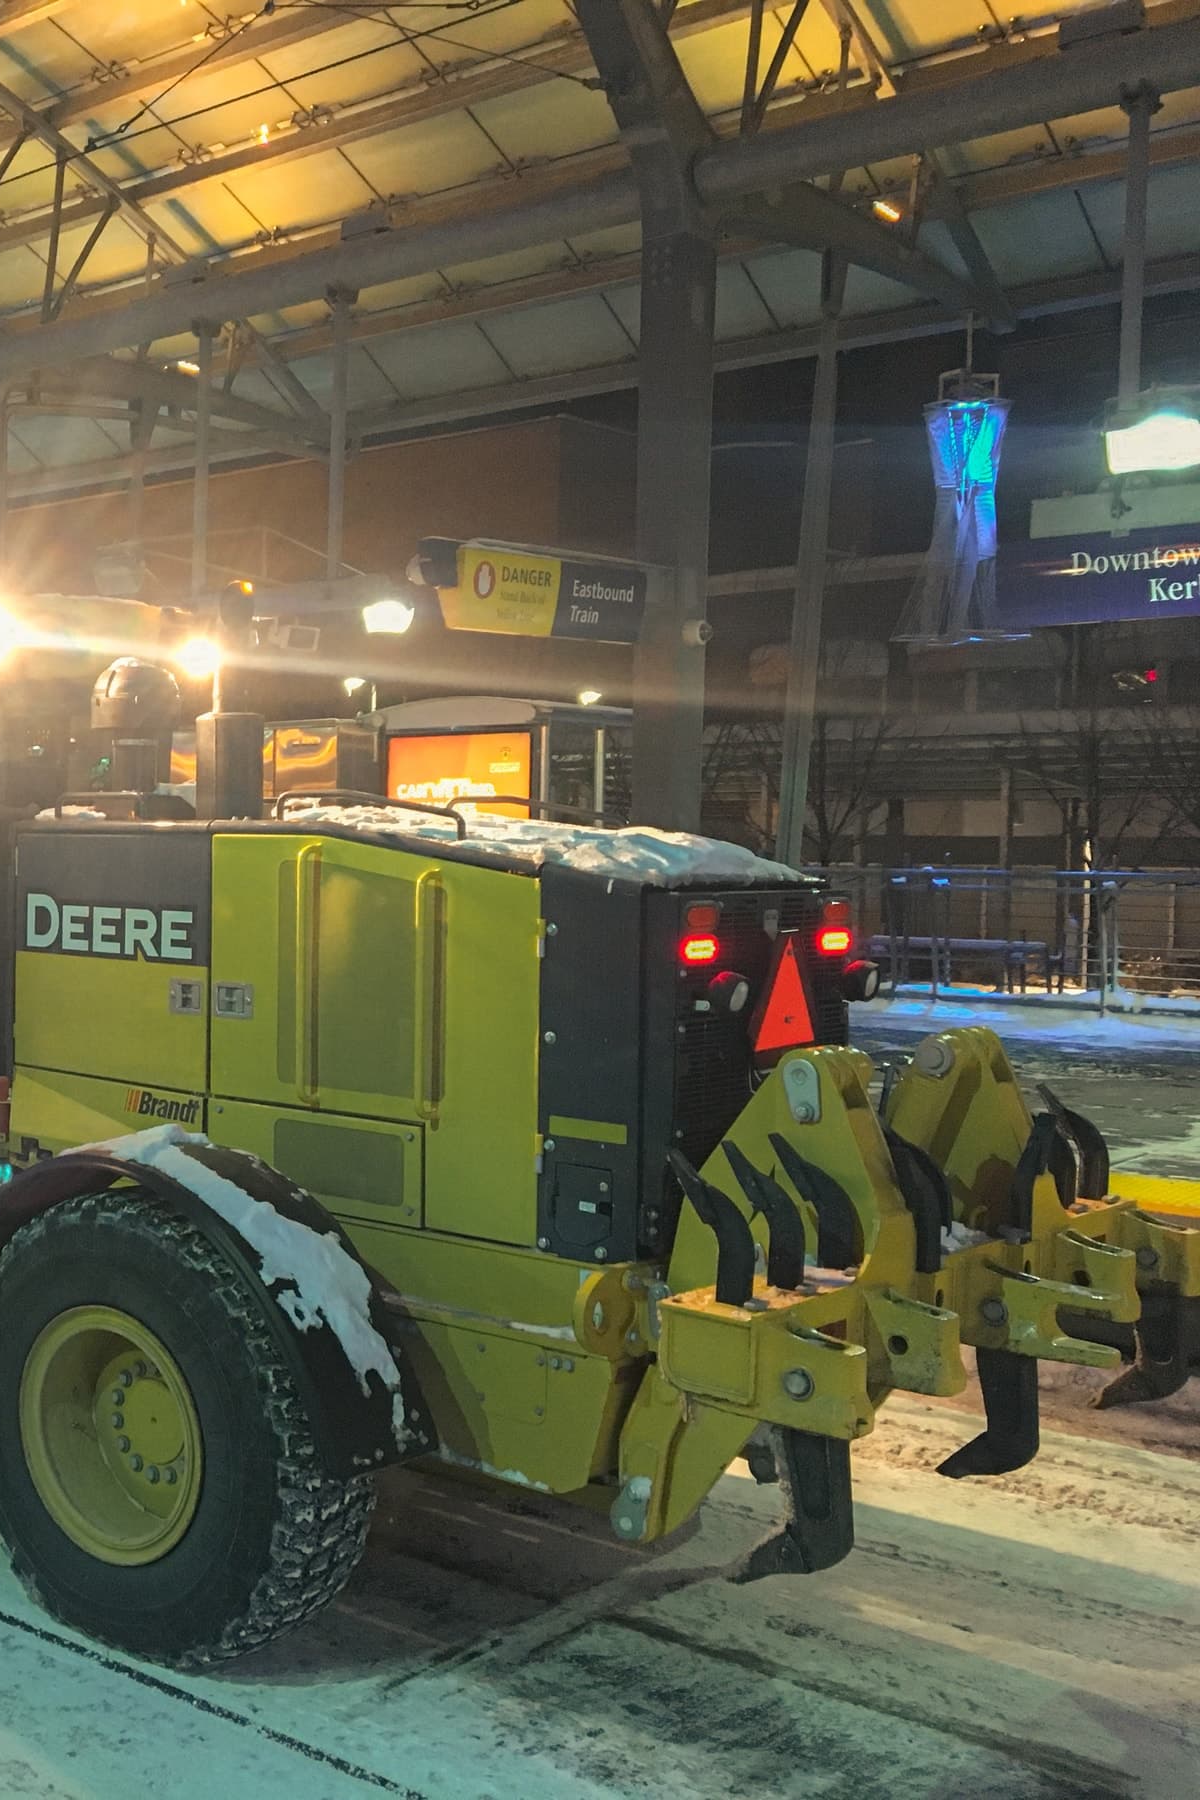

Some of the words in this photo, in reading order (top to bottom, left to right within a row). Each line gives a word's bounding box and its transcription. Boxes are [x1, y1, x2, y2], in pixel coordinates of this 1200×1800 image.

[502, 566, 552, 587] DANGER
[1148, 575, 1200, 602] Ker
[572, 580, 634, 603] Eastbound
[570, 605, 599, 624] Train
[26, 893, 193, 960] DEERE
[137, 1091, 200, 1125] Brandt
